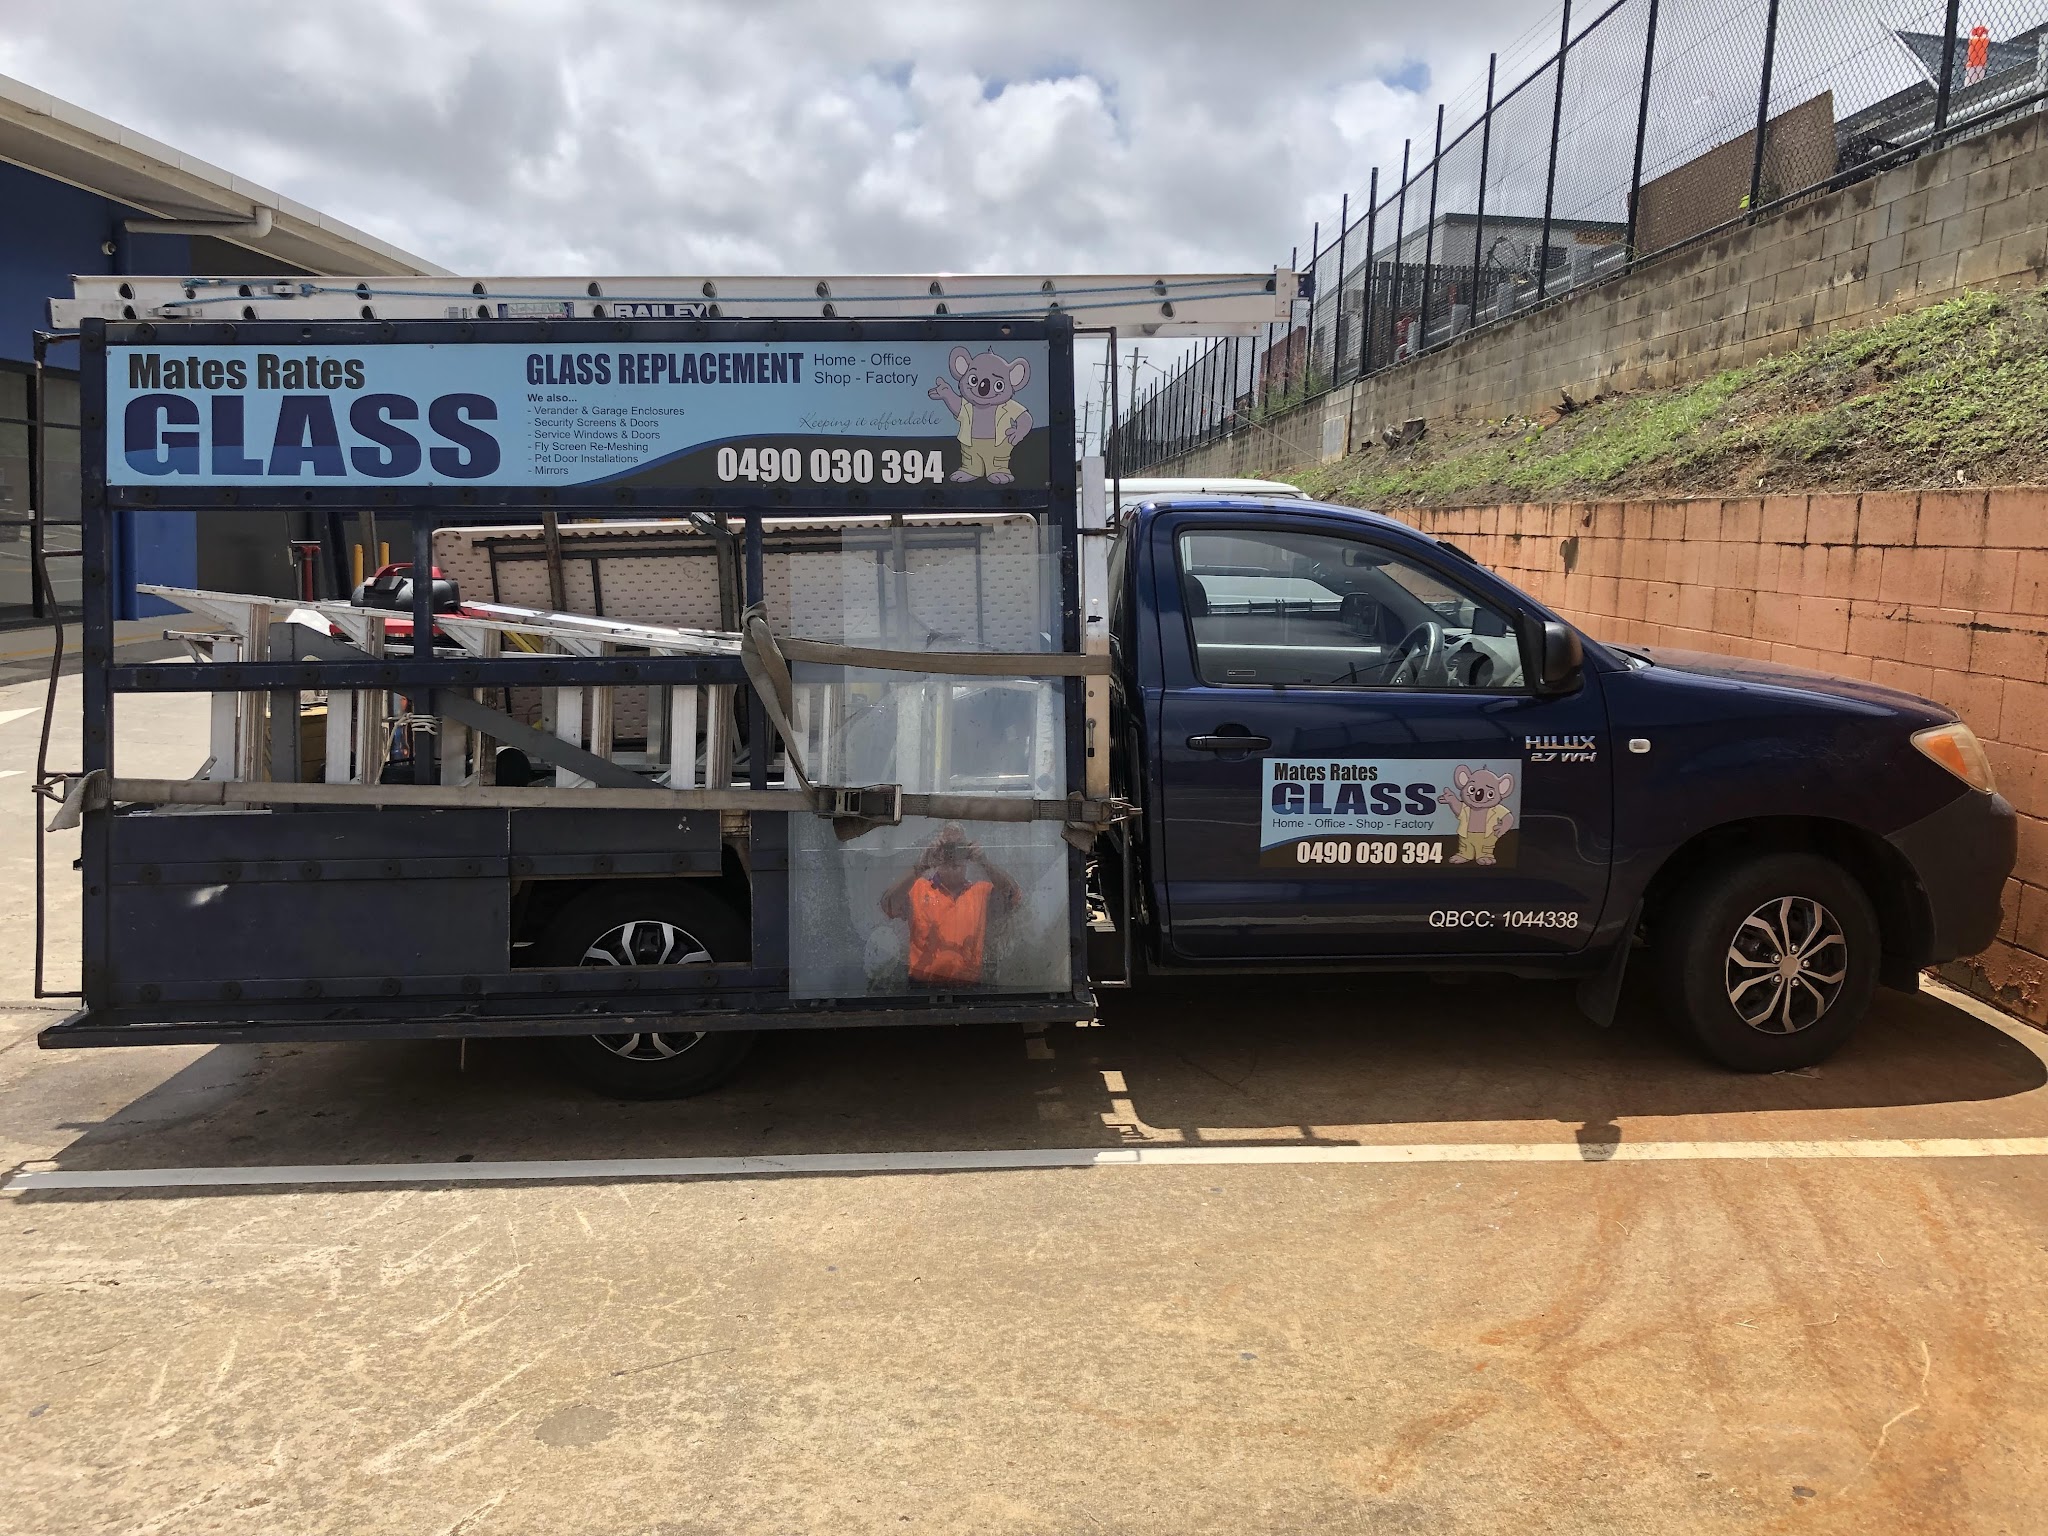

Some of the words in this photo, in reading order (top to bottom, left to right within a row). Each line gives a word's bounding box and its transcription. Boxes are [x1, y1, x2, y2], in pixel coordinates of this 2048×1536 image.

[614, 304, 704, 318] BAILEY
[814, 353, 856, 367] Home
[870, 353, 912, 367] Office
[129, 353, 248, 390] Mates
[257, 353, 366, 390] Rates
[526, 353, 612, 386] GLASS
[618, 352, 804, 385] REPLACEMENT
[814, 371, 852, 387] Shop
[865, 371, 919, 387] Factory
[527, 393, 544, 403] We
[546, 393, 578, 403] also...
[534, 405, 578, 415] Verander
[581, 405, 589, 415] &
[592, 405, 629, 418] Garage
[631, 406, 685, 416] Enclosures
[534, 417, 574, 429] Security
[576, 418, 617, 427] Screens
[619, 418, 627, 427] &
[630, 418, 660, 427] Doors
[799, 411, 851, 433] Keeping
[855, 415, 867, 428] it
[869, 410, 943, 431] affordable
[124, 392, 501, 479] GLASS
[534, 429, 571, 439] Service
[573, 430, 619, 439] Windows
[621, 430, 629, 439] &
[631, 430, 661, 439] Doors
[534, 441, 550, 453] Fly
[552, 441, 587, 451] Screen
[590, 442, 649, 454] Re-Meshing
[534, 453, 552, 463] Pet
[554, 453, 579, 463] Door
[581, 454, 639, 463] Installations
[717, 447, 802, 482] 0490
[810, 448, 874, 484] 030
[881, 449, 945, 484] 394
[535, 465, 570, 475] Mirrors
[1525, 735, 1596, 750] HILUX
[1274, 763, 1326, 781] Mates
[1330, 763, 1378, 781] Rates
[1271, 782, 1437, 816] GLASS
[1272, 818, 1304, 829] Home
[1314, 818, 1346, 829] Office
[1356, 819, 1384, 831] Shop
[1394, 819, 1434, 831] Factory
[1296, 841, 1351, 864] 0490
[1355, 842, 1398, 864] 030
[1401, 842, 1443, 864] 394
[1428, 910, 1496, 928] QBCC:
[1502, 910, 1579, 929] 1044338
